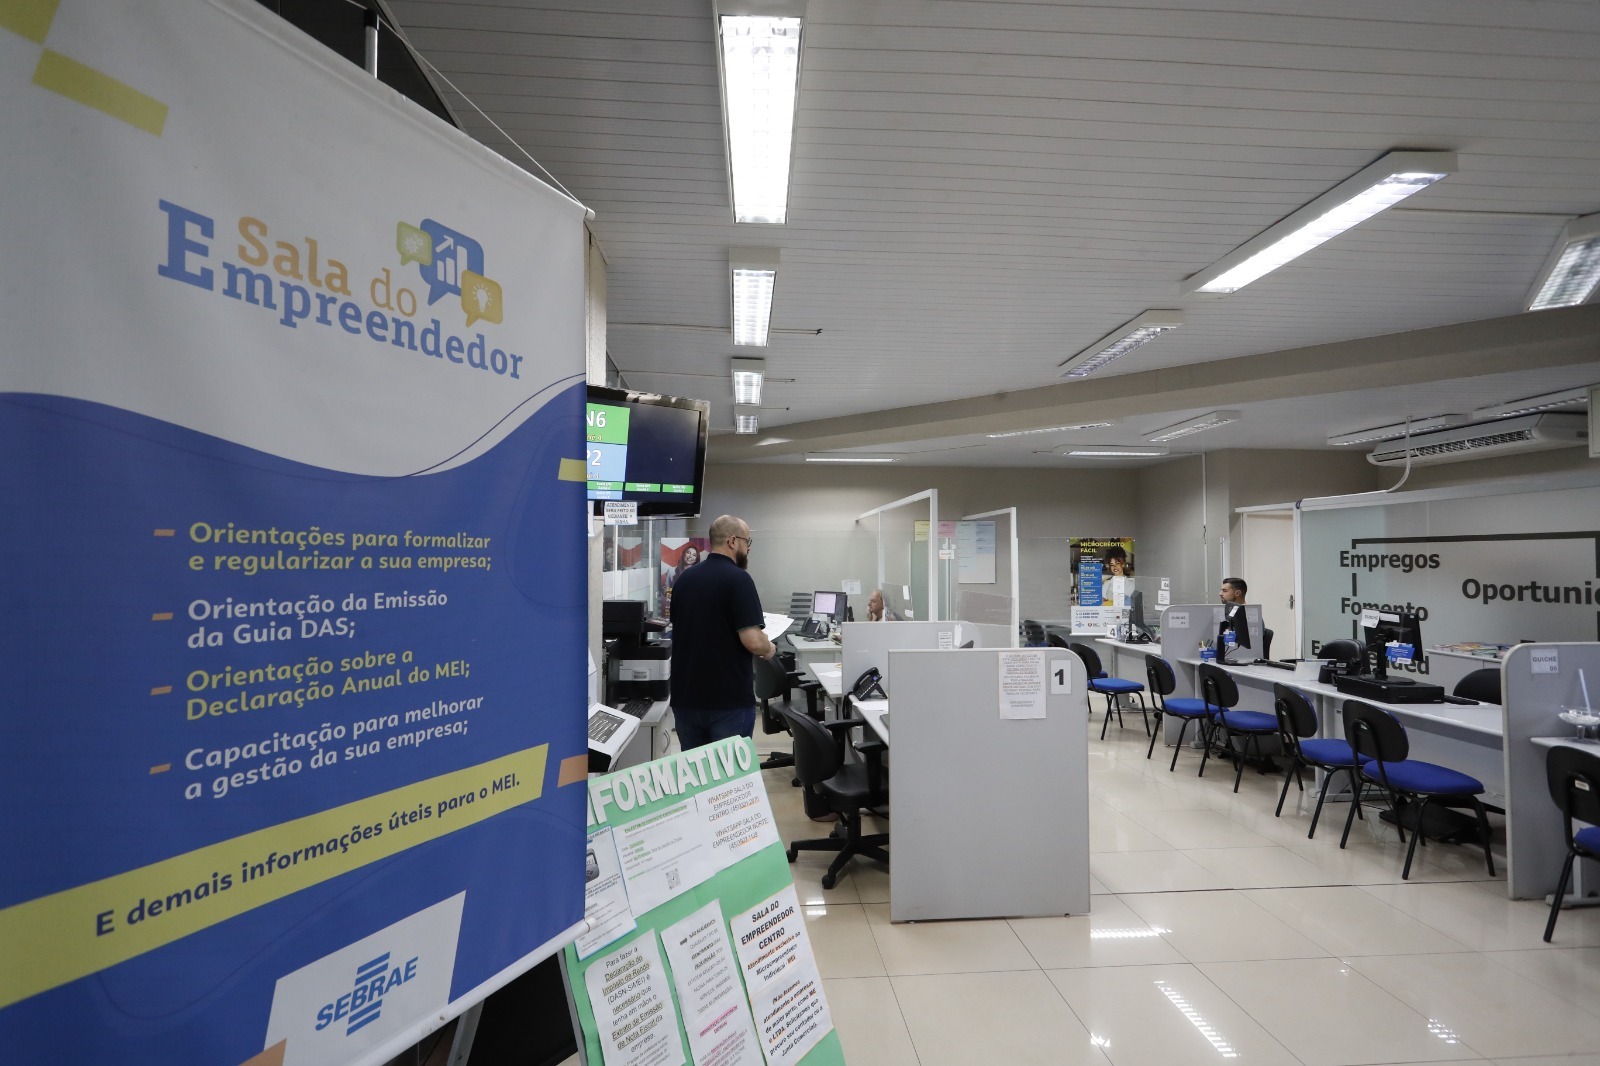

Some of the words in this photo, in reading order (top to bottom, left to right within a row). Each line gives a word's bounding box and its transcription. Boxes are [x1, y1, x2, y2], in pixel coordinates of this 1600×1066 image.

[238, 216, 351, 297] Sala
[370, 268, 417, 318] do
[158, 198, 524, 380] Empreendedor
[189, 522, 345, 552] Orientações
[352, 531, 398, 551] para
[403, 530, 491, 550] formalizar
[189, 553, 204, 570] e
[214, 551, 355, 576] regularizar
[361, 555, 373, 570] a
[378, 555, 412, 570] sua
[417, 554, 492, 573] empresa;
[1339, 550, 1440, 573] Empregos
[188, 594, 334, 621] Orientação
[341, 592, 367, 612] da
[374, 589, 448, 610] Emissão
[187, 627, 223, 649] da
[233, 621, 293, 644] Guia
[300, 617, 355, 640] DAS;
[186, 656, 334, 693] Orientação
[340, 650, 396, 672] sobre
[402, 650, 414, 664] a
[186, 682, 334, 721] Declaração
[341, 670, 402, 696] Anual
[407, 664, 429, 685] do
[435, 660, 470, 680] MEI;
[1054, 668, 1064, 685] 1
[185, 720, 347, 772] Capacitação
[352, 713, 399, 740] para
[404, 696, 484, 724] melhorar
[184, 780, 202, 800] a
[212, 755, 303, 797] gestão
[310, 748, 338, 770] da
[344, 740, 380, 761] sua
[386, 719, 469, 752] empresa;
[95, 910, 116, 938] E
[126, 873, 233, 926] demais
[241, 820, 383, 885] informações
[388, 802, 433, 831] úteis
[437, 789, 476, 820] para
[479, 787, 488, 799] o
[492, 772, 520, 794] MEI.
[741, 906, 795, 945] EMPREENDEDOR
[752, 907, 770, 923] SALA
[771, 900, 779, 911] DO
[759, 927, 785, 950] CENTRO
[315, 956, 419, 1032] SEBRAE
